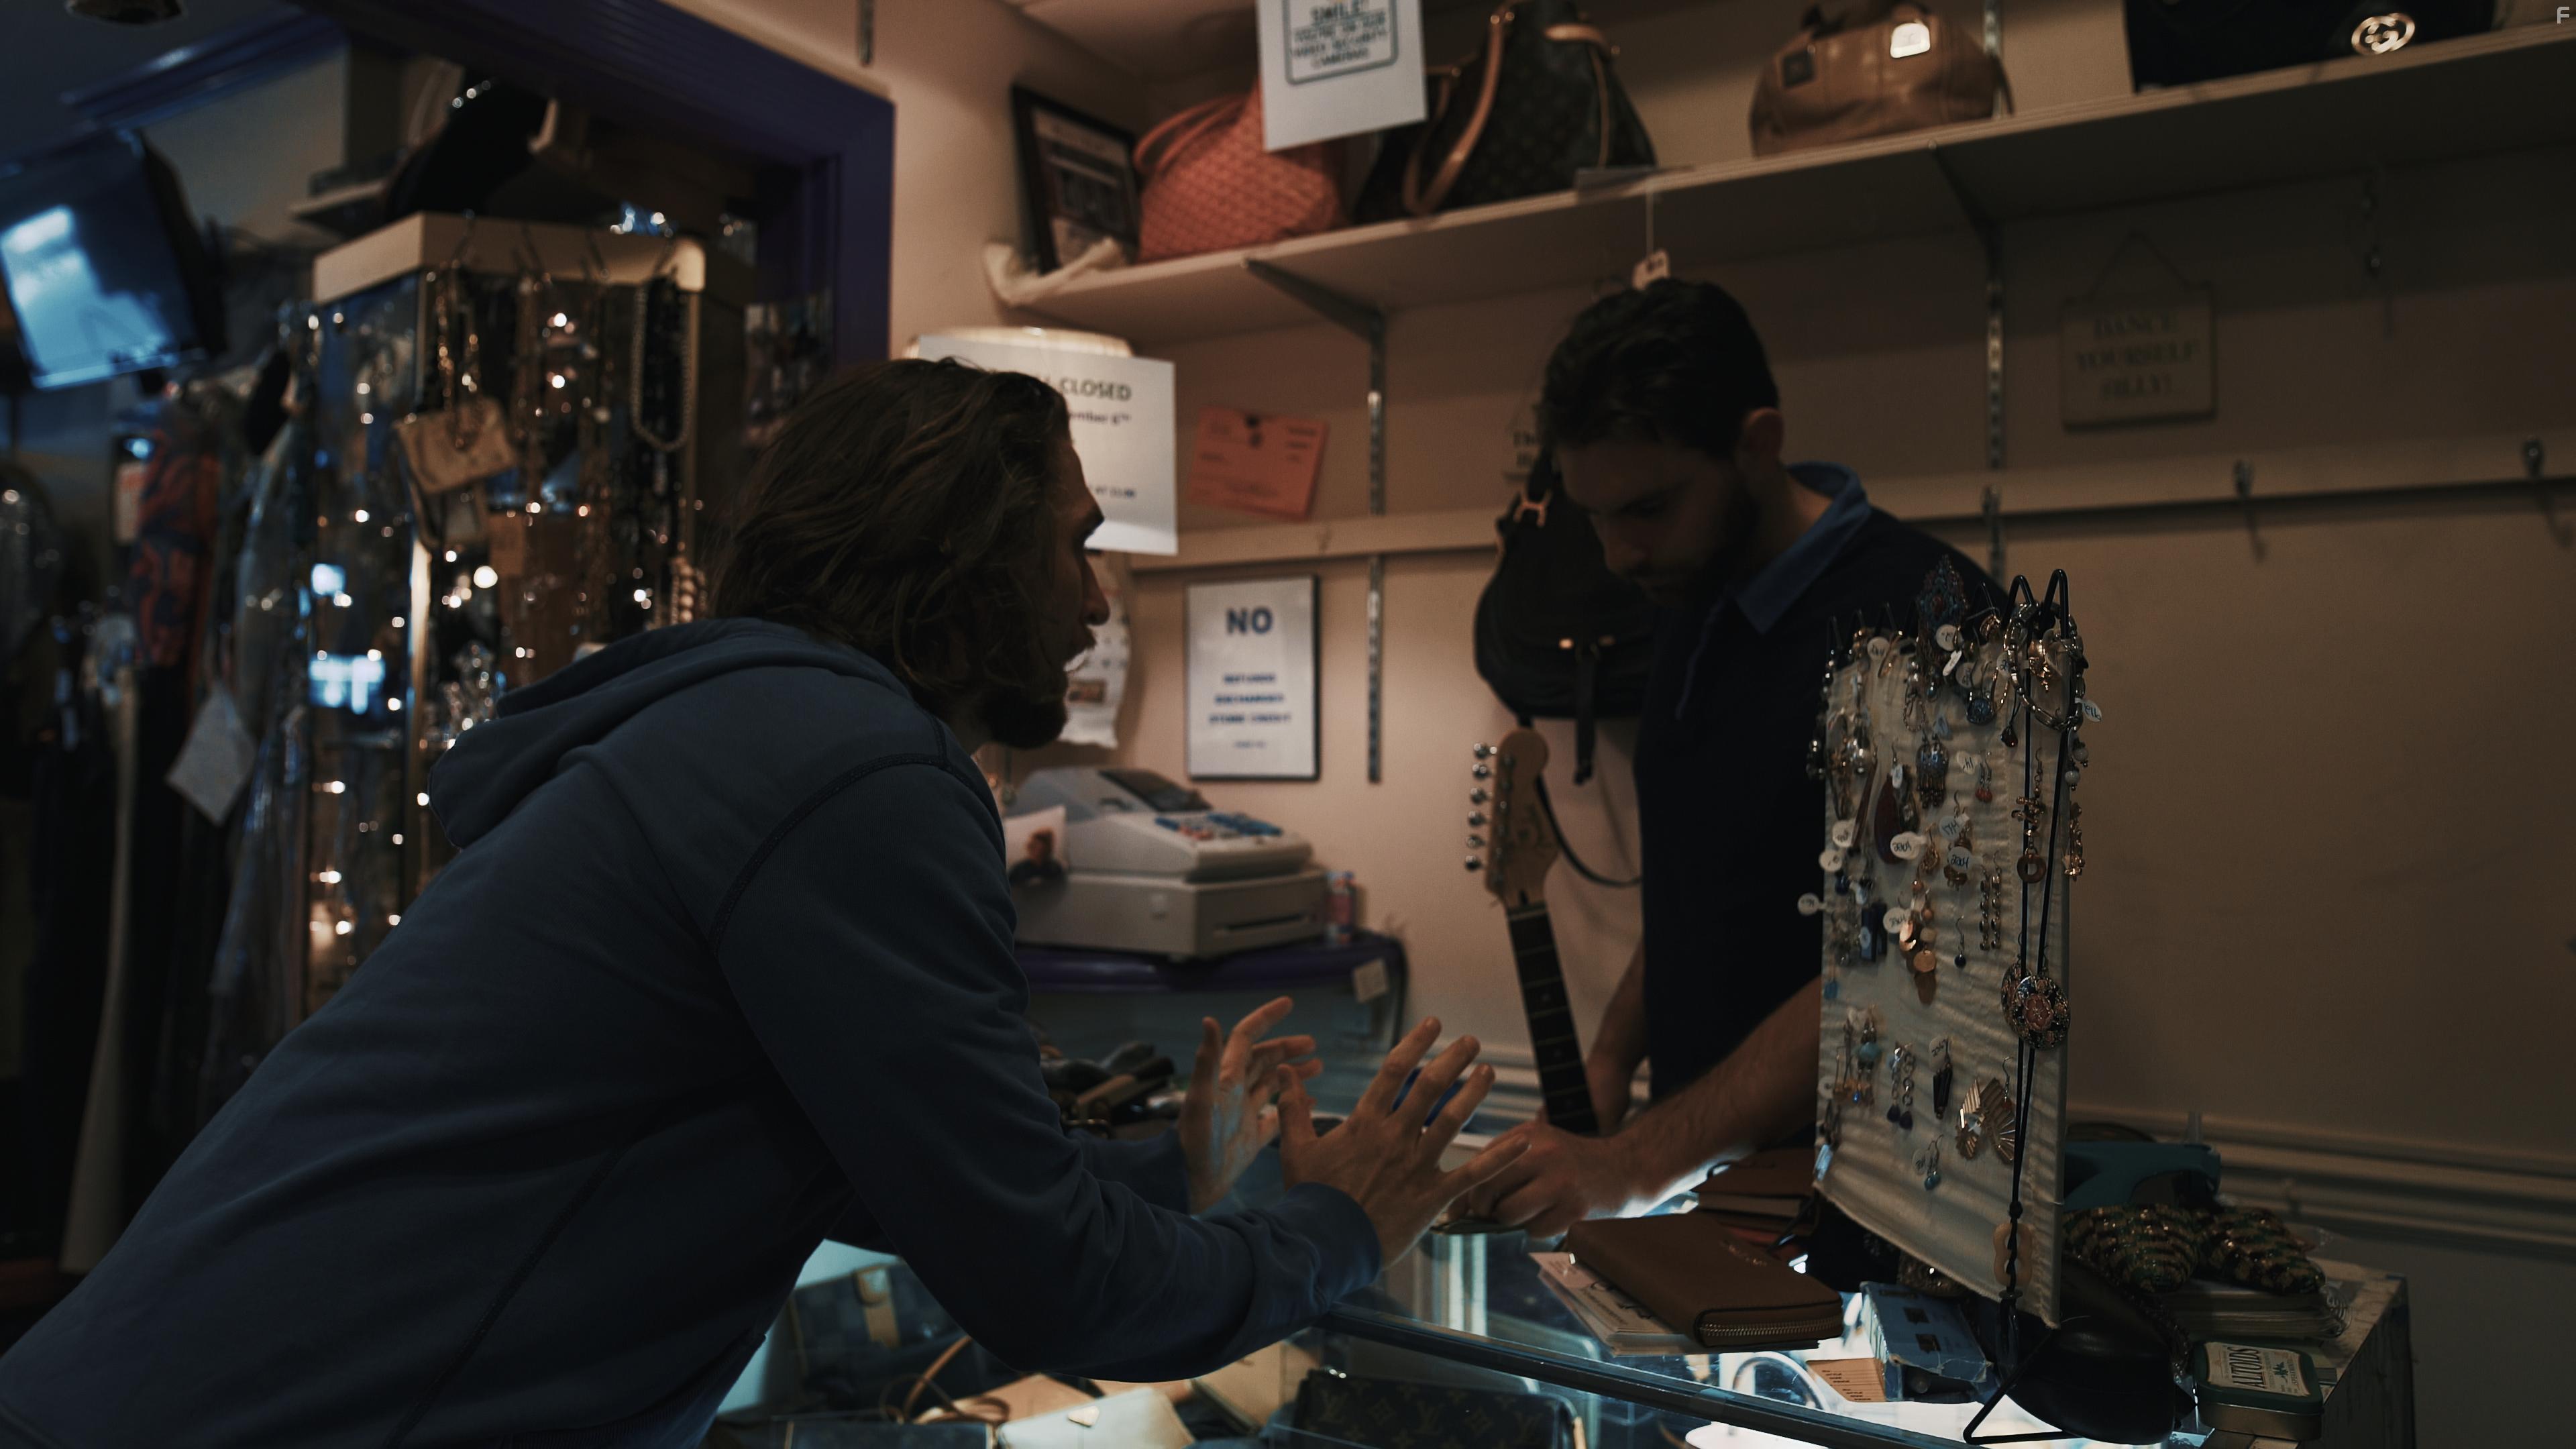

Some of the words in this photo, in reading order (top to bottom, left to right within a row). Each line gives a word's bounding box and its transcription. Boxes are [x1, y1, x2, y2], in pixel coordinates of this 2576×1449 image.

[1059, 378, 1132, 401] CLOSED
[1226, 606, 1273, 635] NO
[2227, 1346, 2265, 1388] ALTOIDS
